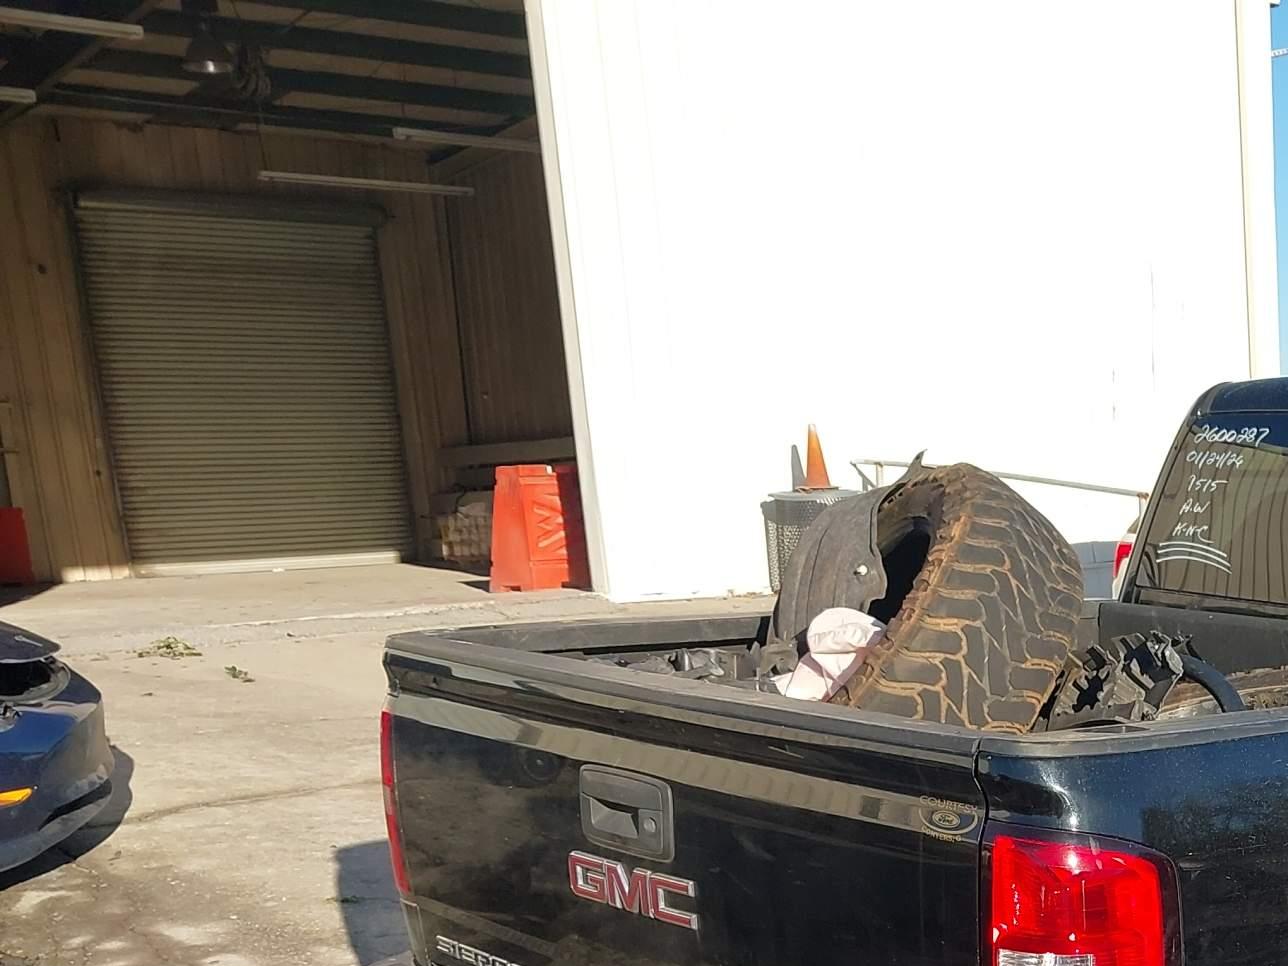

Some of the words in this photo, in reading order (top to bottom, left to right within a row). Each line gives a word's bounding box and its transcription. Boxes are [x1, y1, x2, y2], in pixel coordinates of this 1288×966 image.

[1194, 424, 1270, 448] 2600287
[919, 795, 978, 814] COURTESY
[568, 850, 698, 931] GMC
